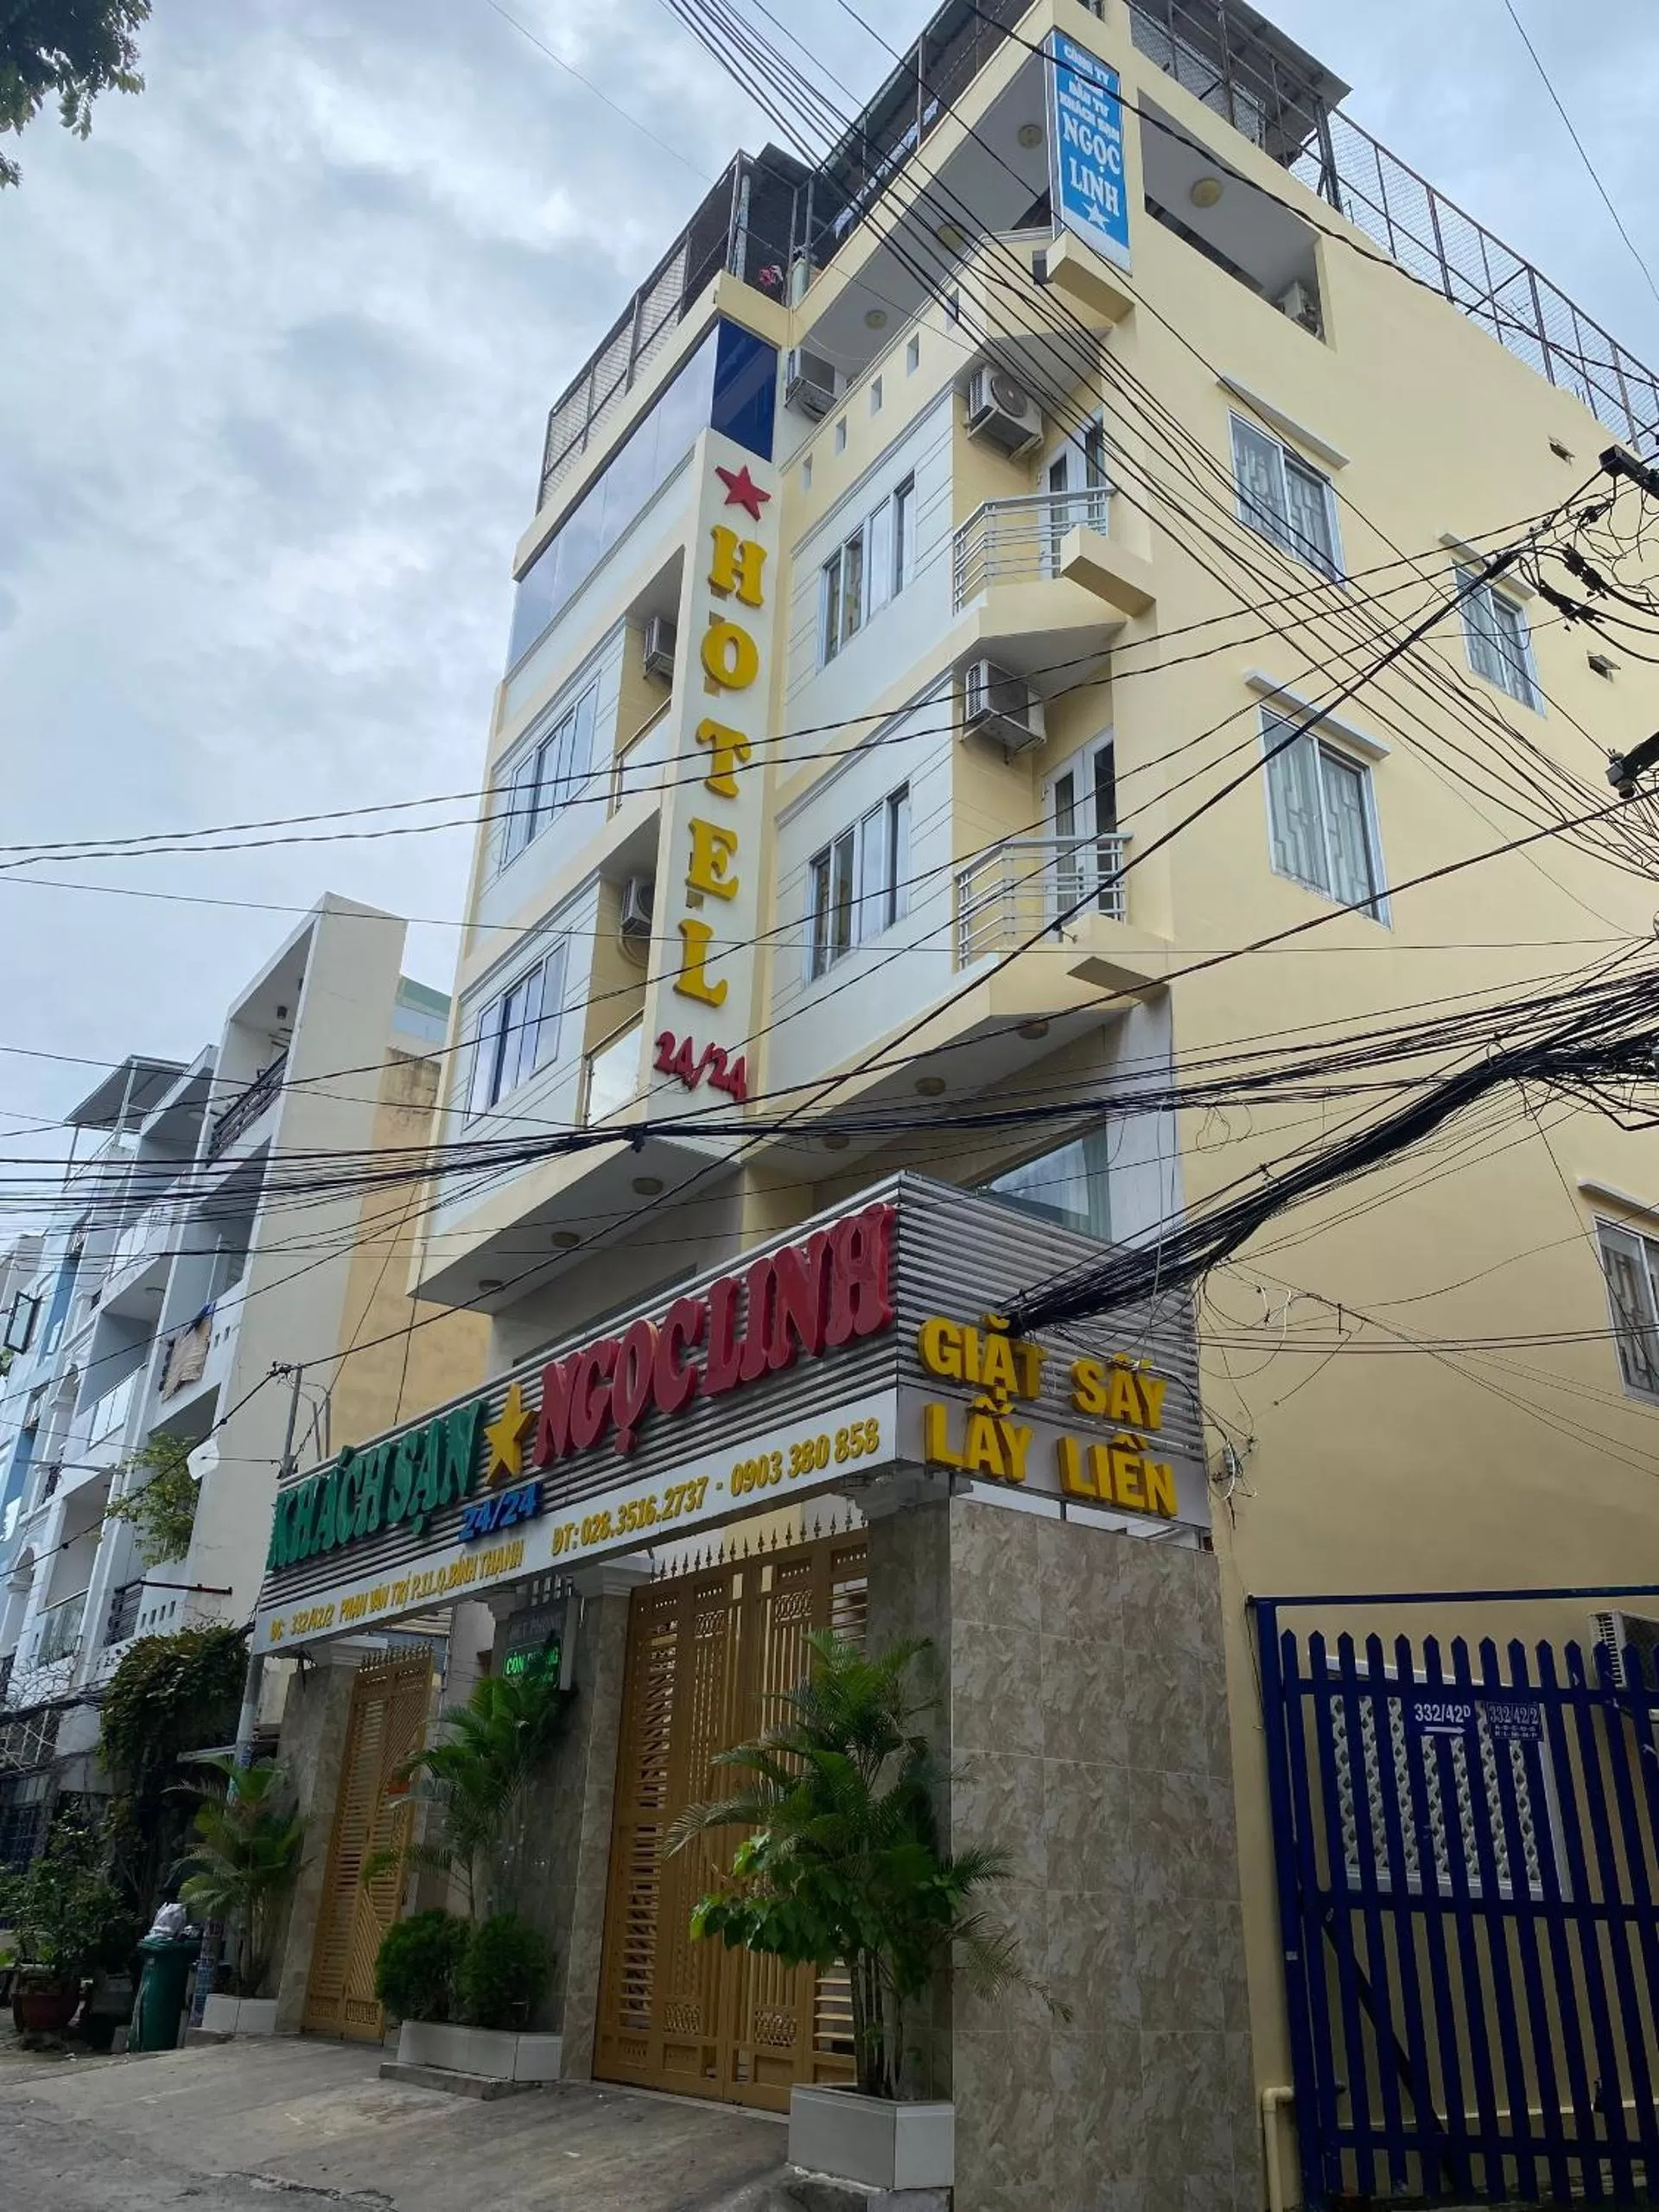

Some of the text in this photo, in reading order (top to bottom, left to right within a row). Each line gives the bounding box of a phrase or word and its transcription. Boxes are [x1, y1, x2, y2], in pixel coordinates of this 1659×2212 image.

[1063, 111, 1121, 175] NGỌC
[1069, 156, 1121, 217] LINH
[672, 524, 767, 1008] HOTEL
[653, 1029, 747, 1101] 24/24
[264, 1203, 898, 1572] KHÁCH SẠN NGỌC LINH
[918, 1313, 1049, 1403] GIẶT
[730, 1450, 783, 1497] 0903
[787, 1433, 830, 1478] 380
[835, 1418, 880, 1464] 858
[458, 1482, 543, 1543] 24/24
